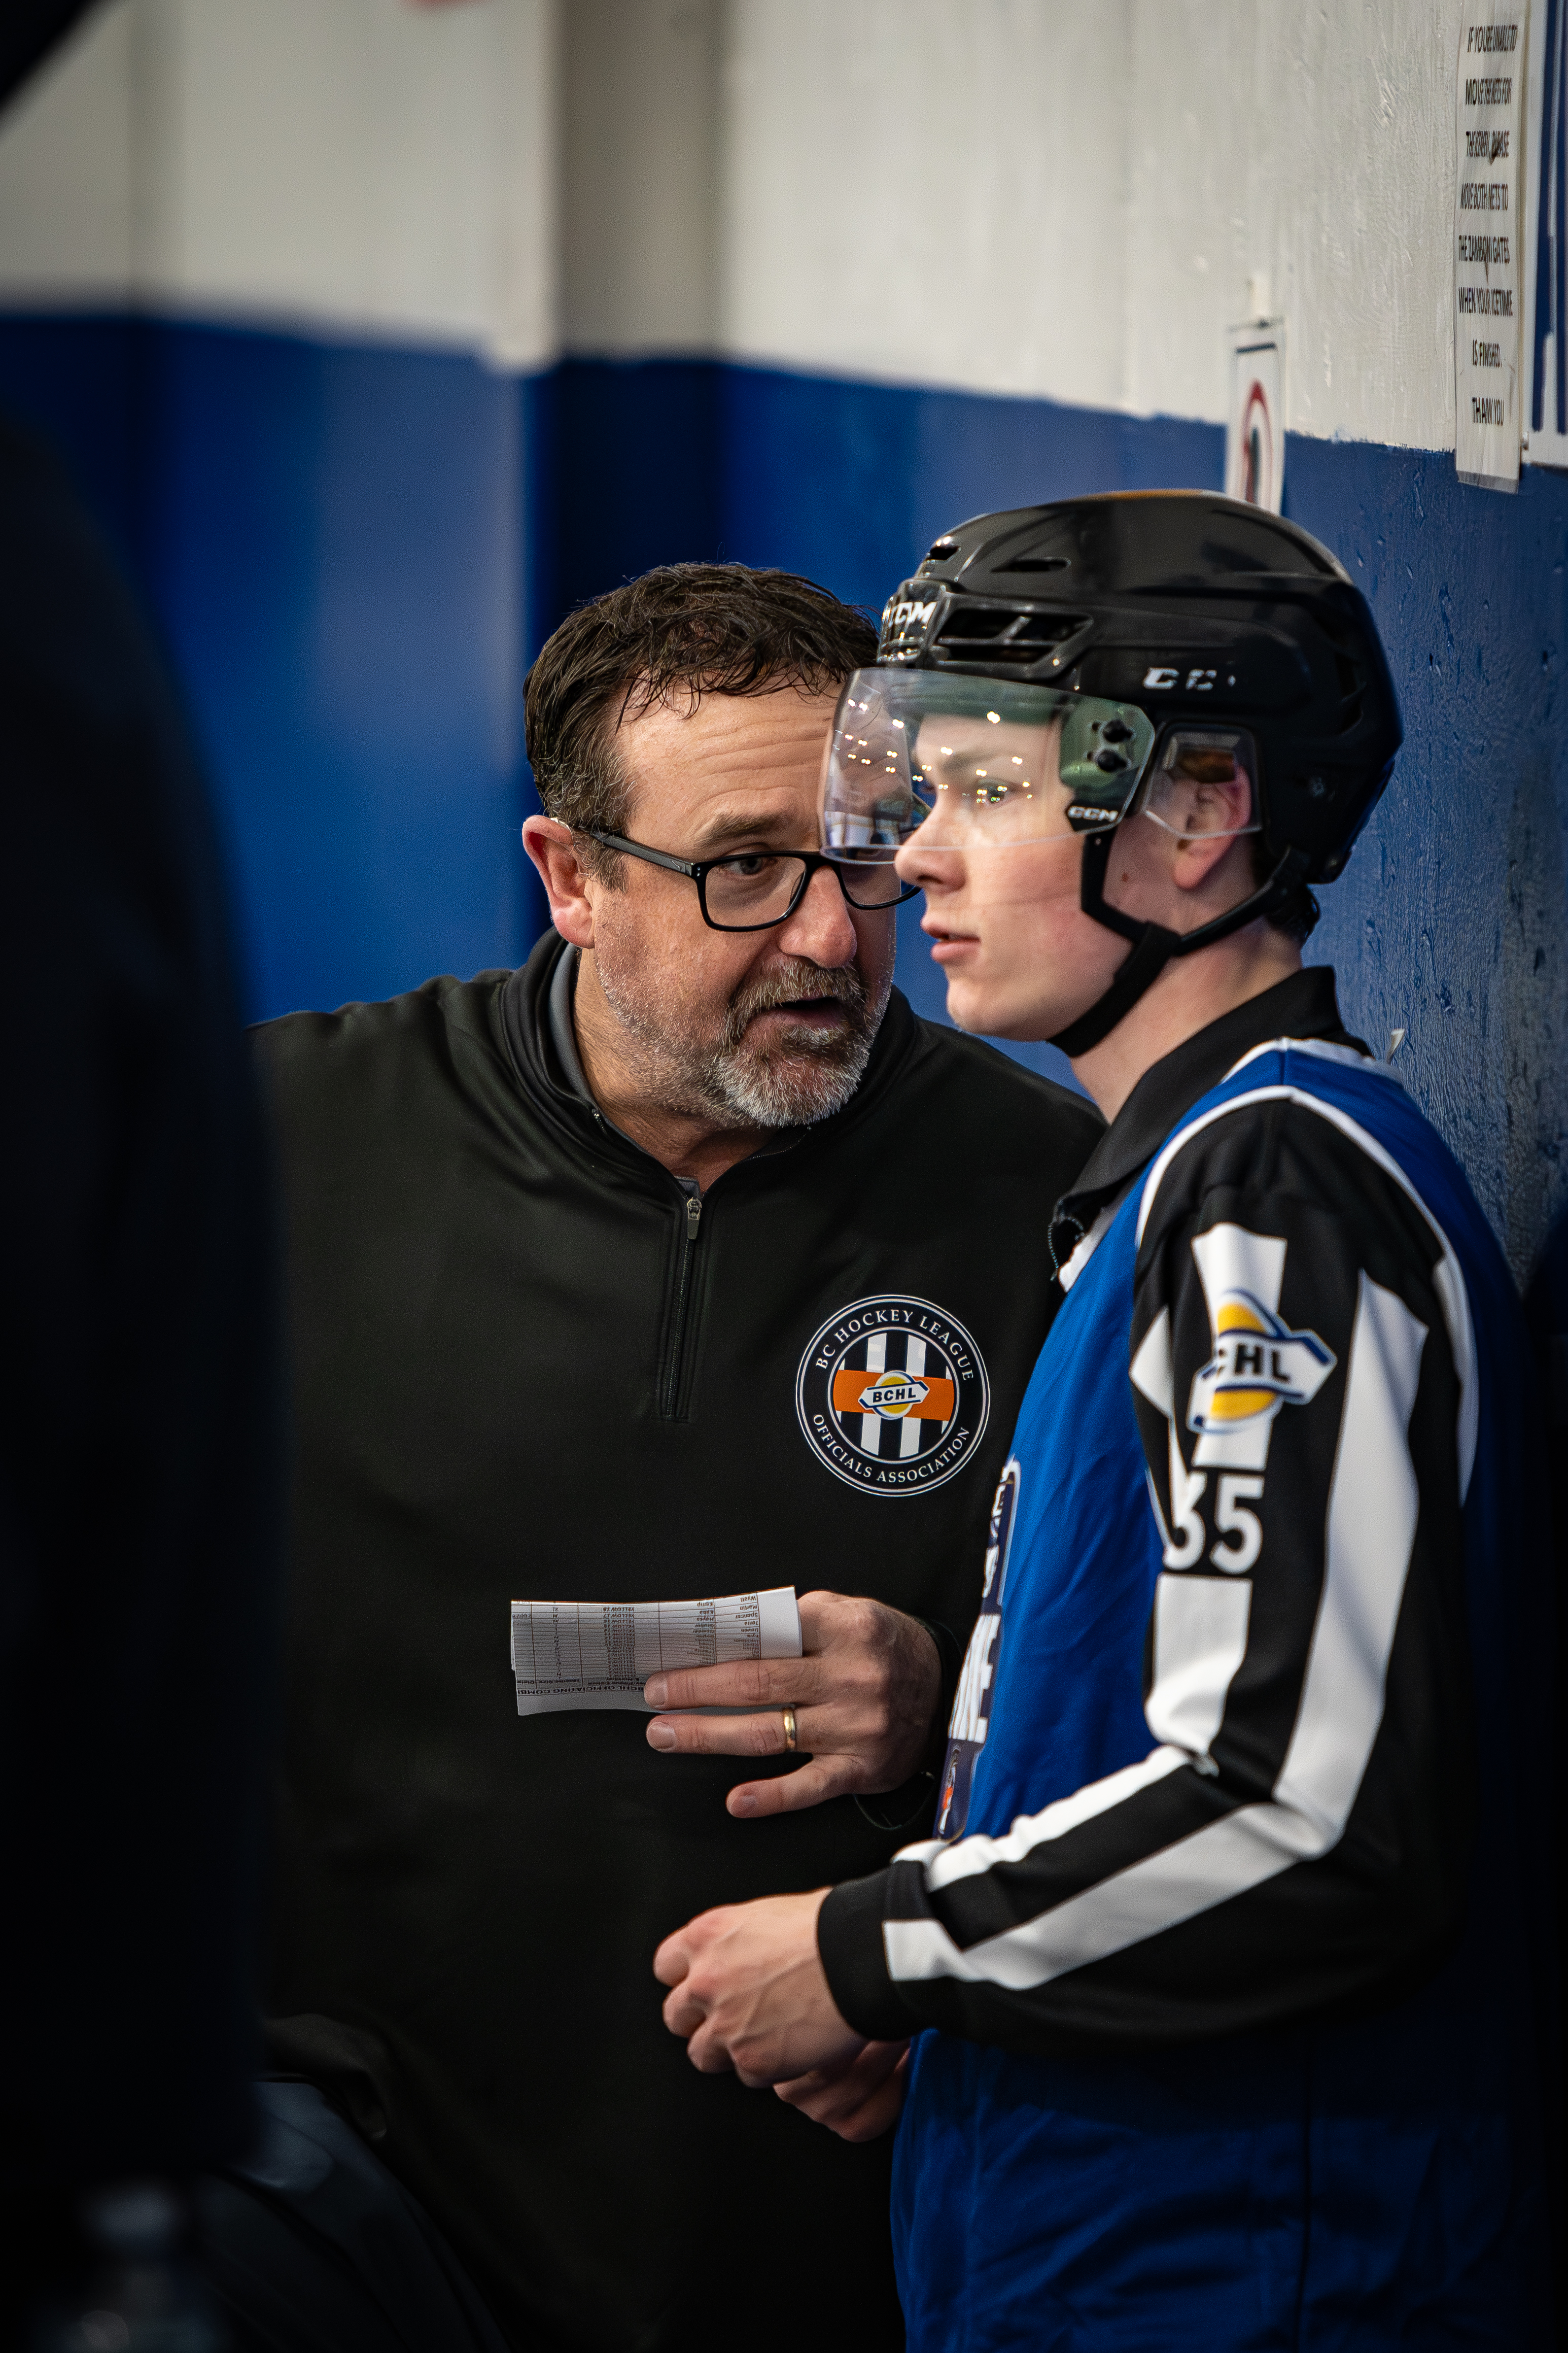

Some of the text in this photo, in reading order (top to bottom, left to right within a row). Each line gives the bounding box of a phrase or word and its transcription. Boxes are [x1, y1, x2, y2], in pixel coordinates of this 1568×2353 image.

[1468, 26, 1474, 52] IF
[1493, 24, 1510, 52] UNABLE
[1510, 24, 1518, 52] TO
[1466, 78, 1512, 105] MOVE THE NETS FOR
[1466, 130, 1476, 157] THE
[1460, 183, 1509, 210] MOVE BOTH NETS TO
[1459, 235, 1510, 264] THE ZAMBONI GATES
[1459, 286, 1476, 313] WHEN
[1477, 287, 1491, 315] YOUR
[1473, 339, 1503, 367] IS FINISHED.
[1472, 397, 1504, 426] THANK YOU
[1143, 667, 1236, 691] CC
[1068, 806, 1118, 822] CCM
[815, 1309, 974, 1380] BC HOCKEY LEAGUE
[872, 1387, 917, 1403] BCHL
[813, 1414, 970, 1483] OFFICIALS ASSOCIATION
